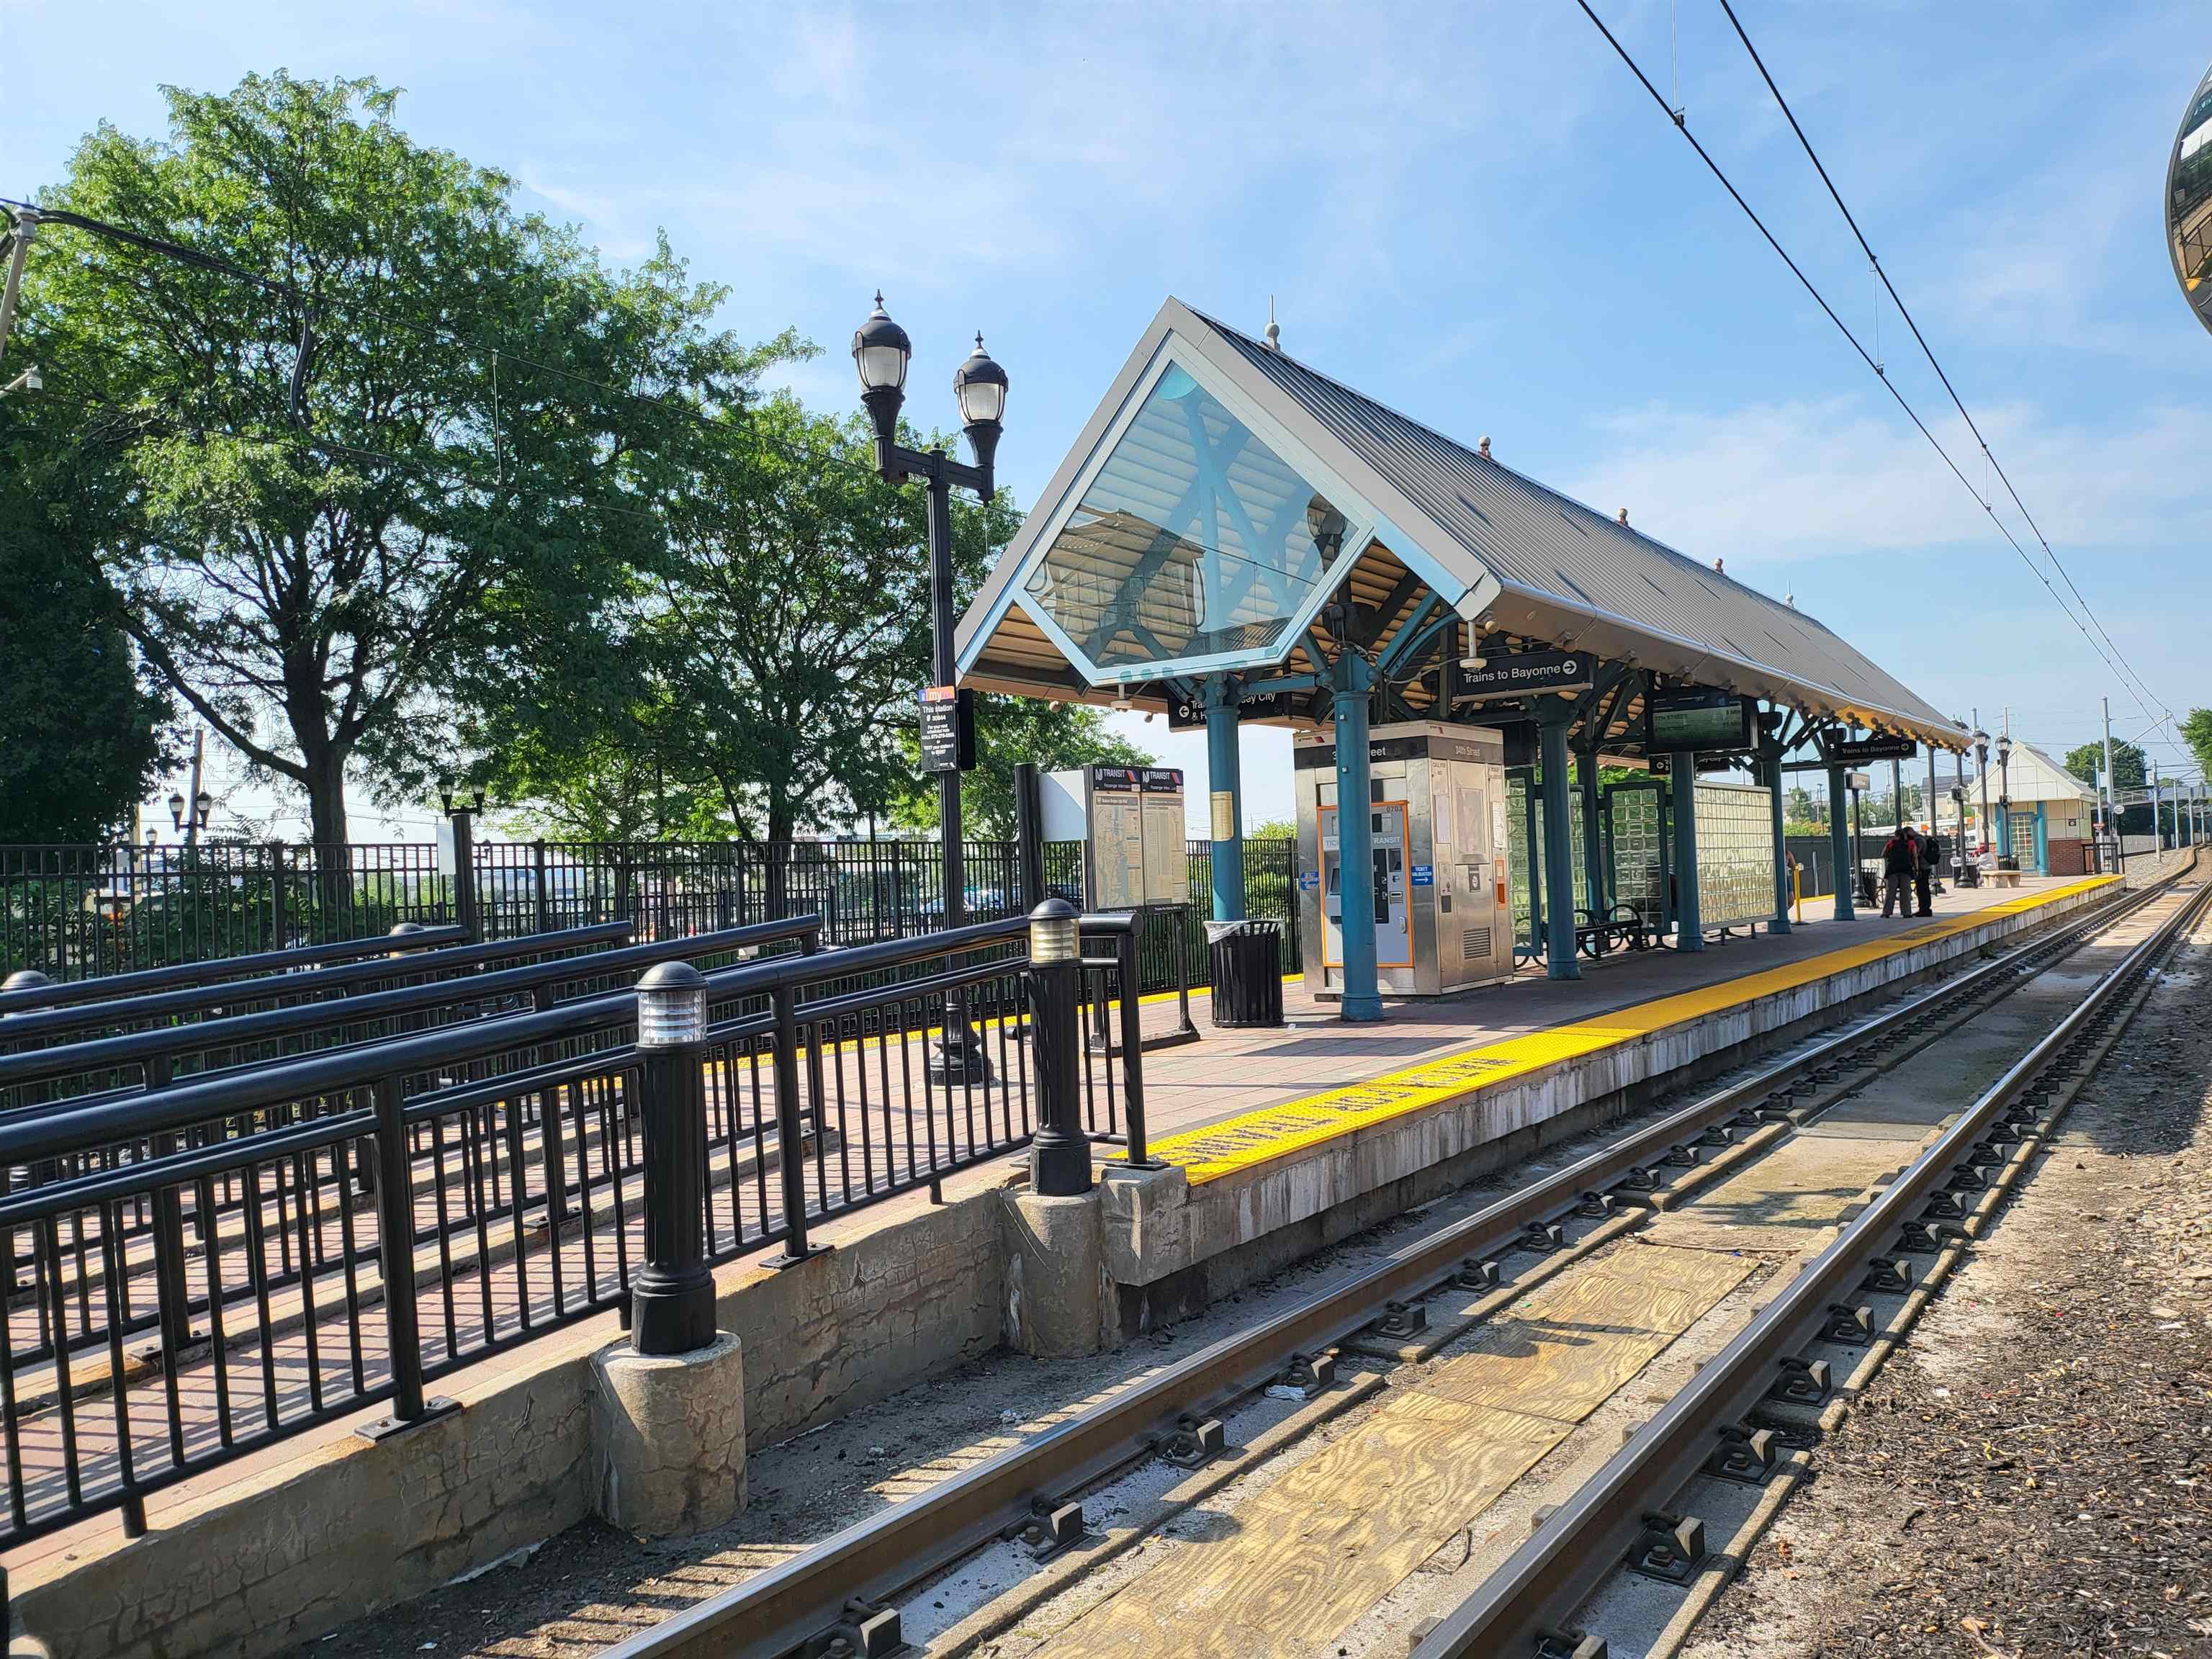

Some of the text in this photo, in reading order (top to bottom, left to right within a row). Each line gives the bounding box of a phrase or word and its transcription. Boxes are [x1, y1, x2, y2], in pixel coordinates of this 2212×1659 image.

[1463, 665, 1561, 683] Trains to Bayonne
[1191, 691, 1276, 709] Tra sey City
[935, 704, 953, 713] station
[1192, 712, 1199, 721] &
[1370, 746, 1387, 757] eet
[1870, 744, 1900, 754] Bayonne
[1103, 768, 1125, 778] TRANSIT
[1150, 771, 1170, 780] TRANSIT
[1310, 1088, 1416, 1112] FOR
[1146, 1113, 1339, 1165] TRAINS
